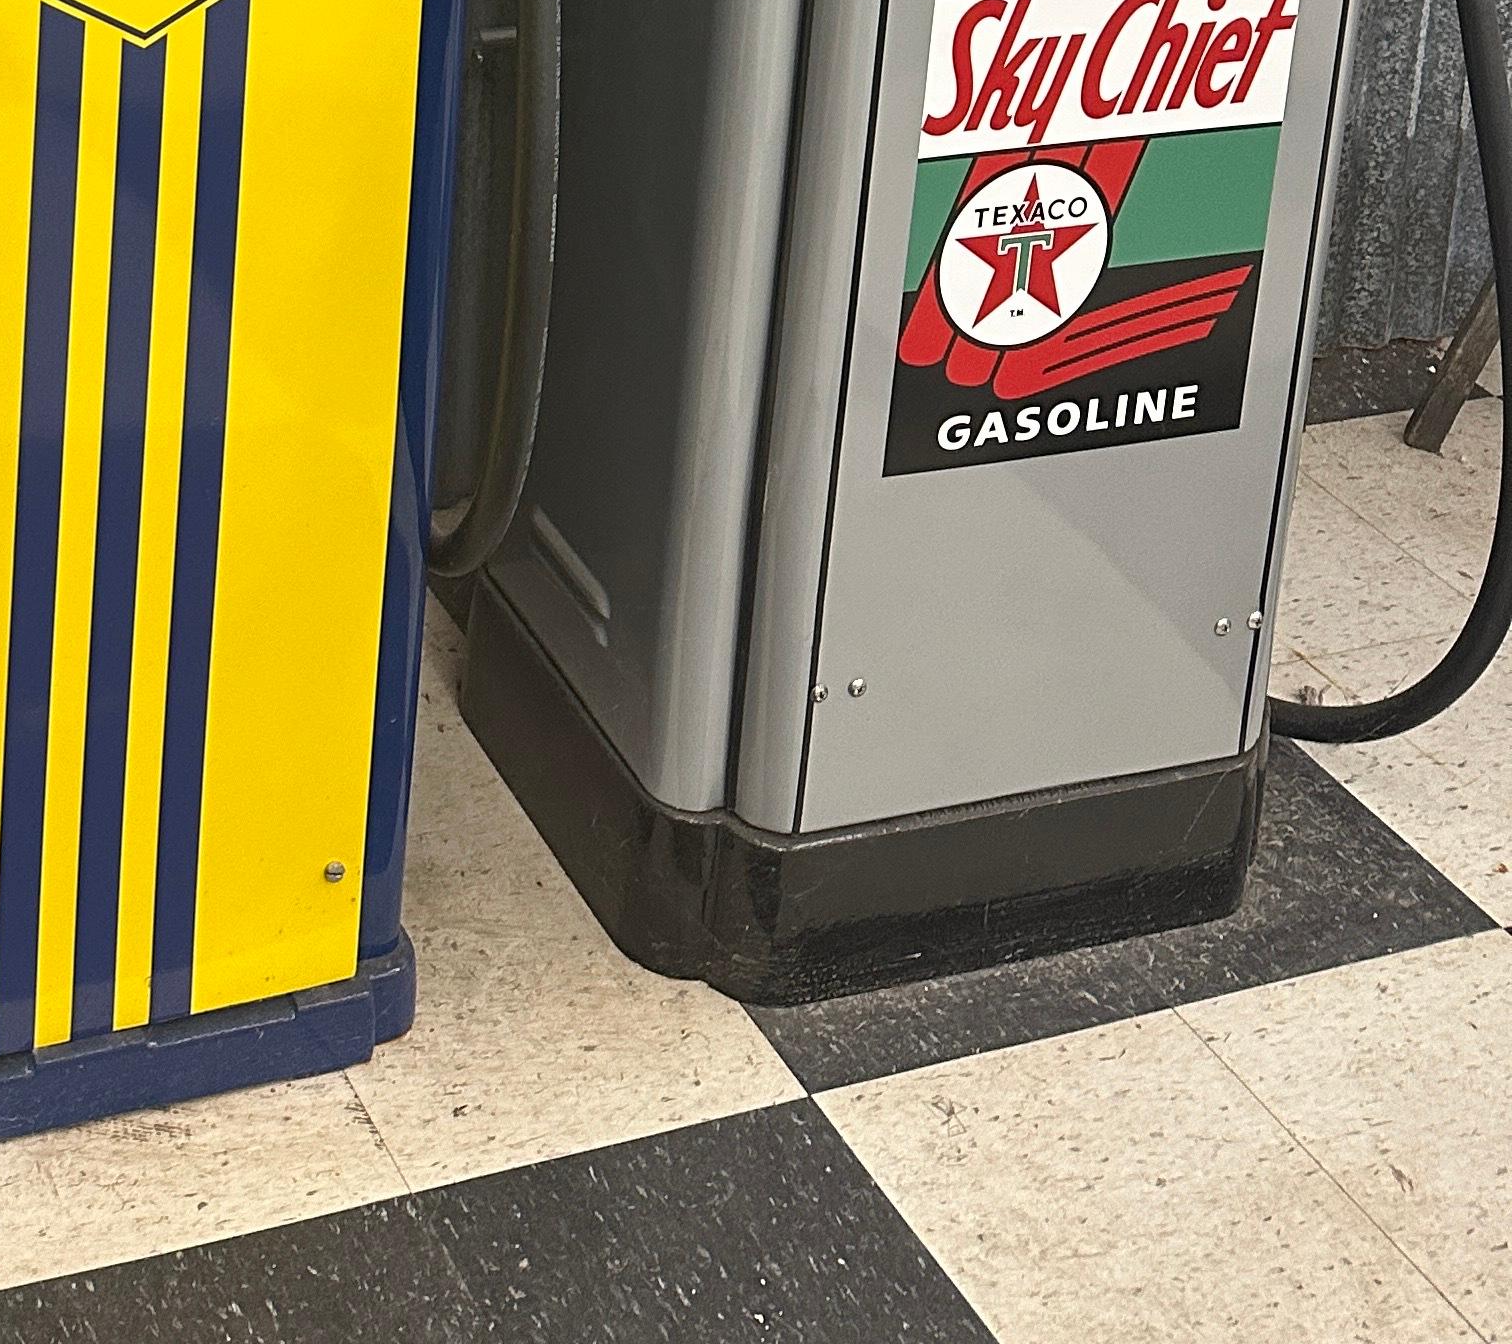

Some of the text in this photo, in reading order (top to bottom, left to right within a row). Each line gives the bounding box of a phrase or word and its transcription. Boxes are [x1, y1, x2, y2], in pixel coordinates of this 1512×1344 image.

[974, 196, 1088, 229] TEXACO
[999, 233, 1052, 293] T
[937, 385, 1199, 451] GASOLINE
